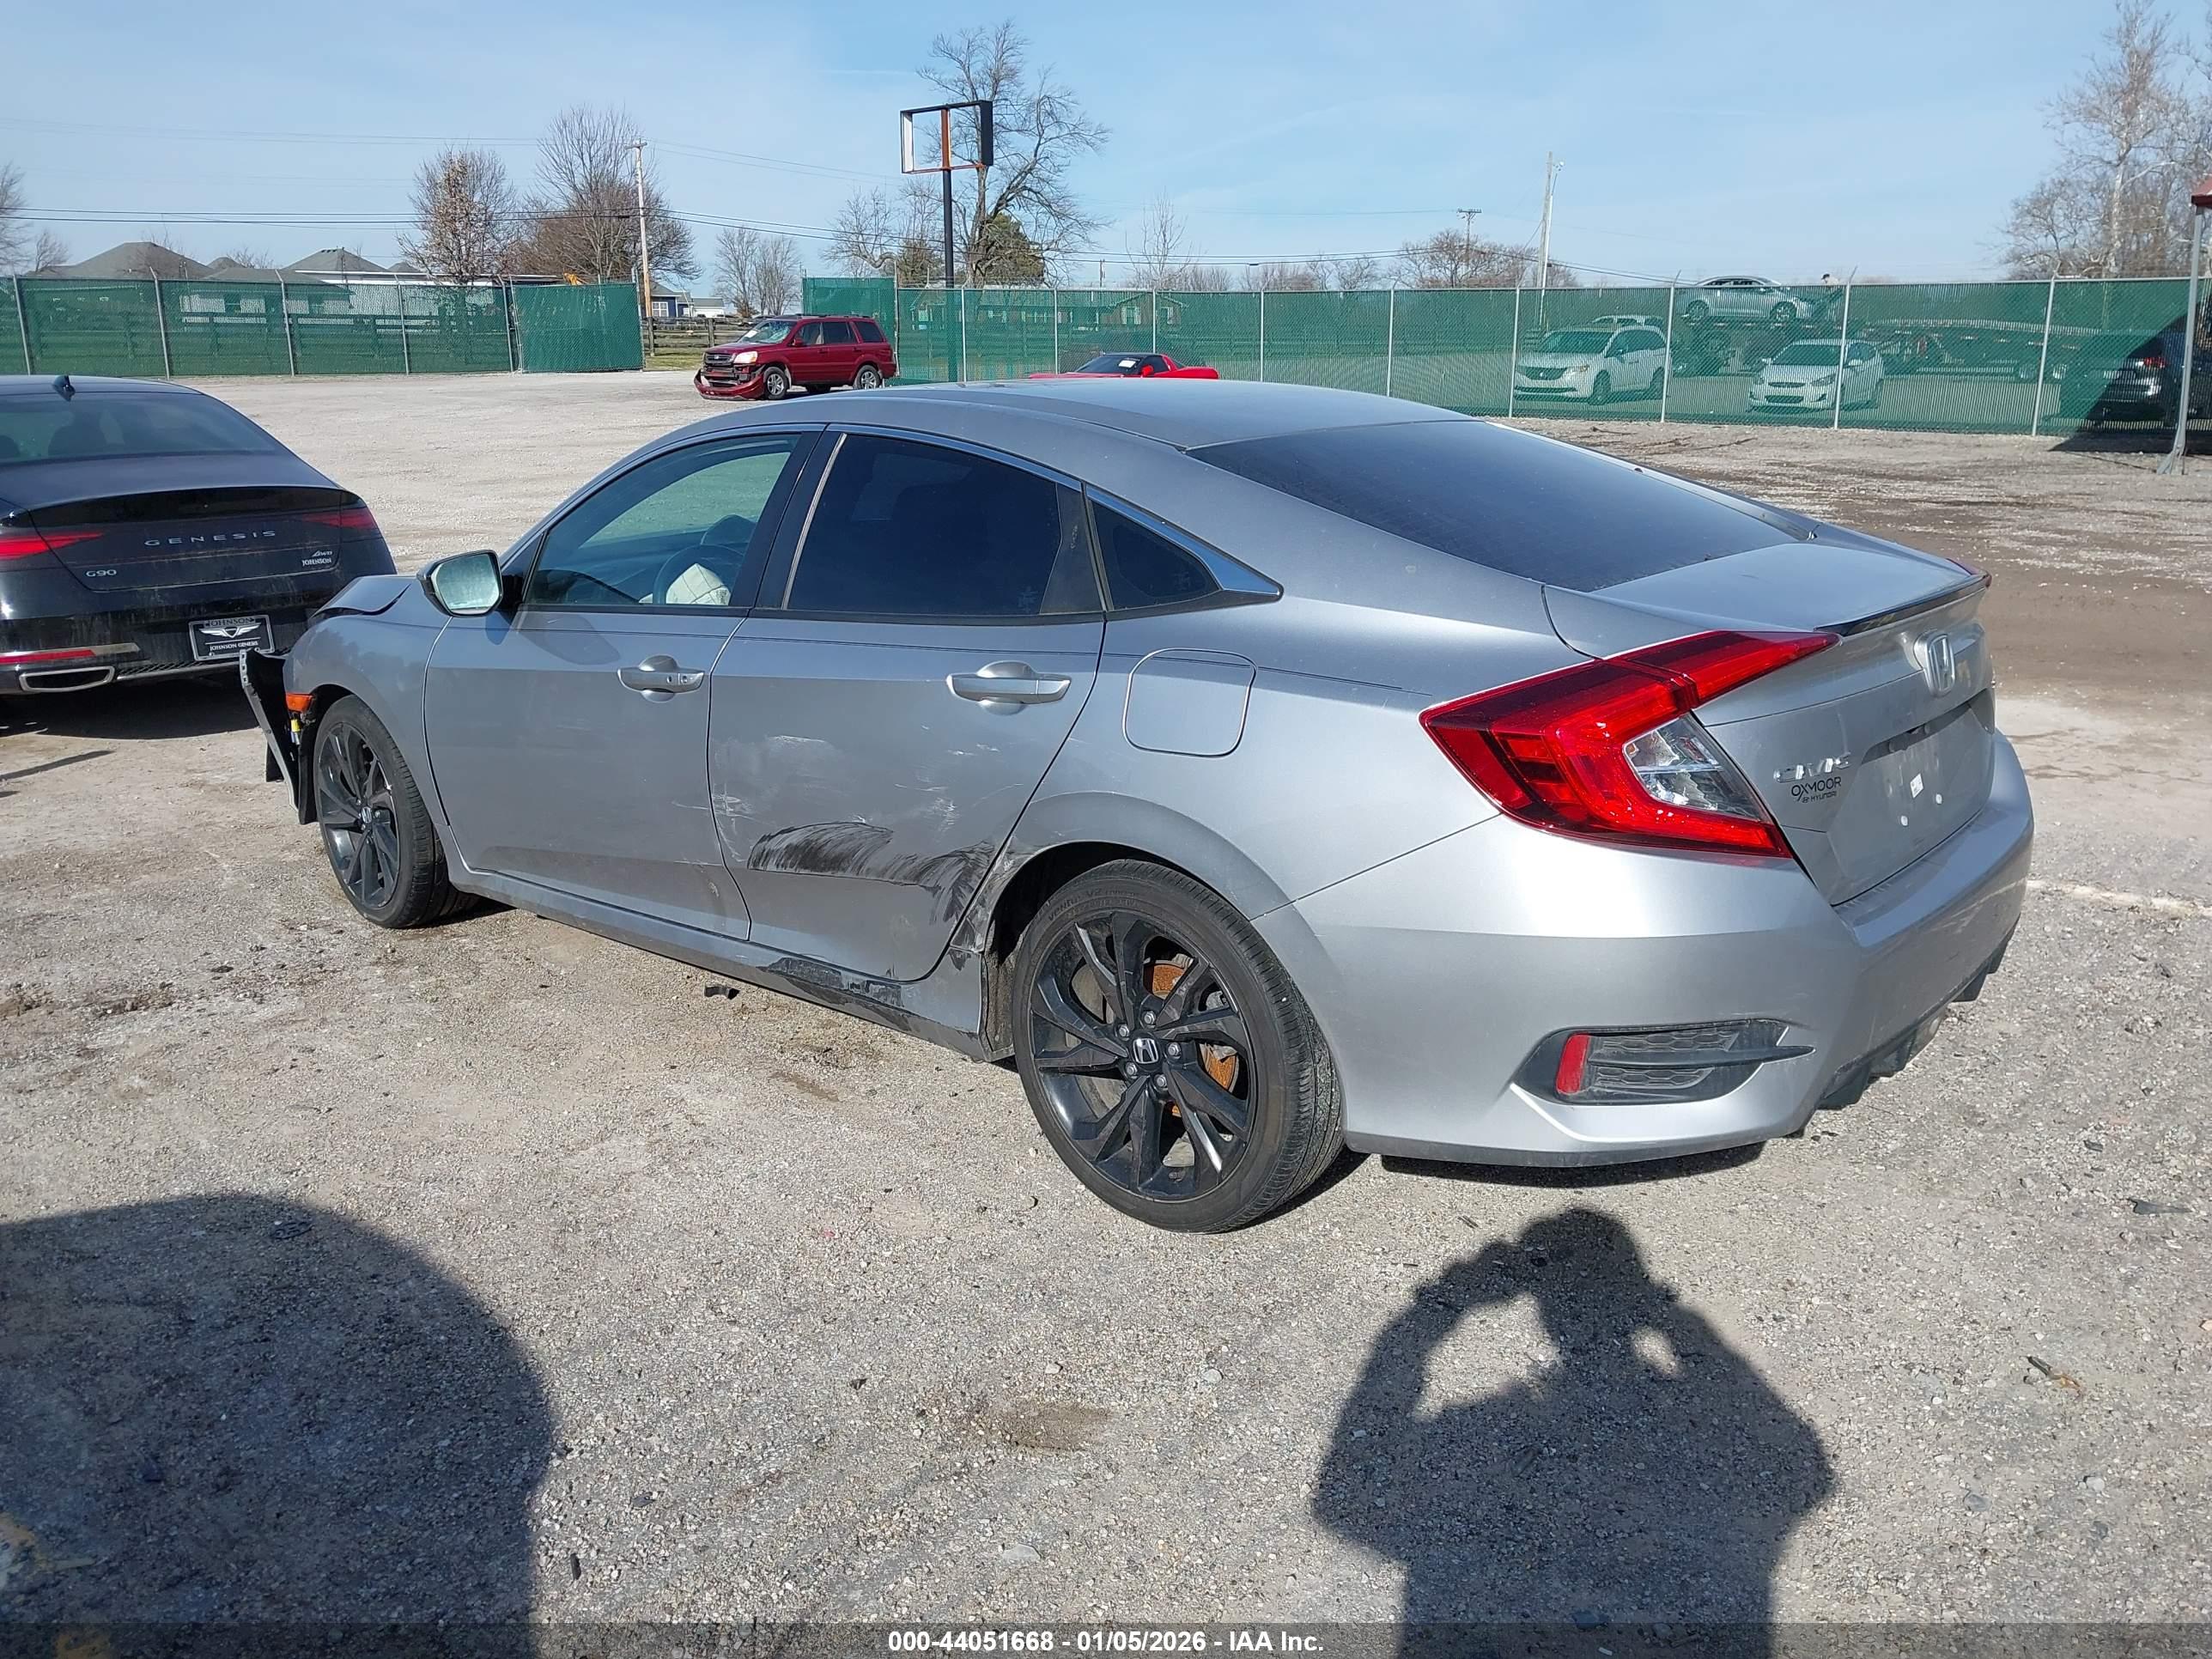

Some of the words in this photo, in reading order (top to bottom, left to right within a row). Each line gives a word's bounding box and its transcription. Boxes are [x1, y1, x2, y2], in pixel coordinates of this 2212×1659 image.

[144, 531, 276, 546] GENESIS
[302, 557, 332, 567] JOHNSON
[210, 642, 237, 651] JOHNSON
[1791, 776, 1841, 801] OXMOOR
